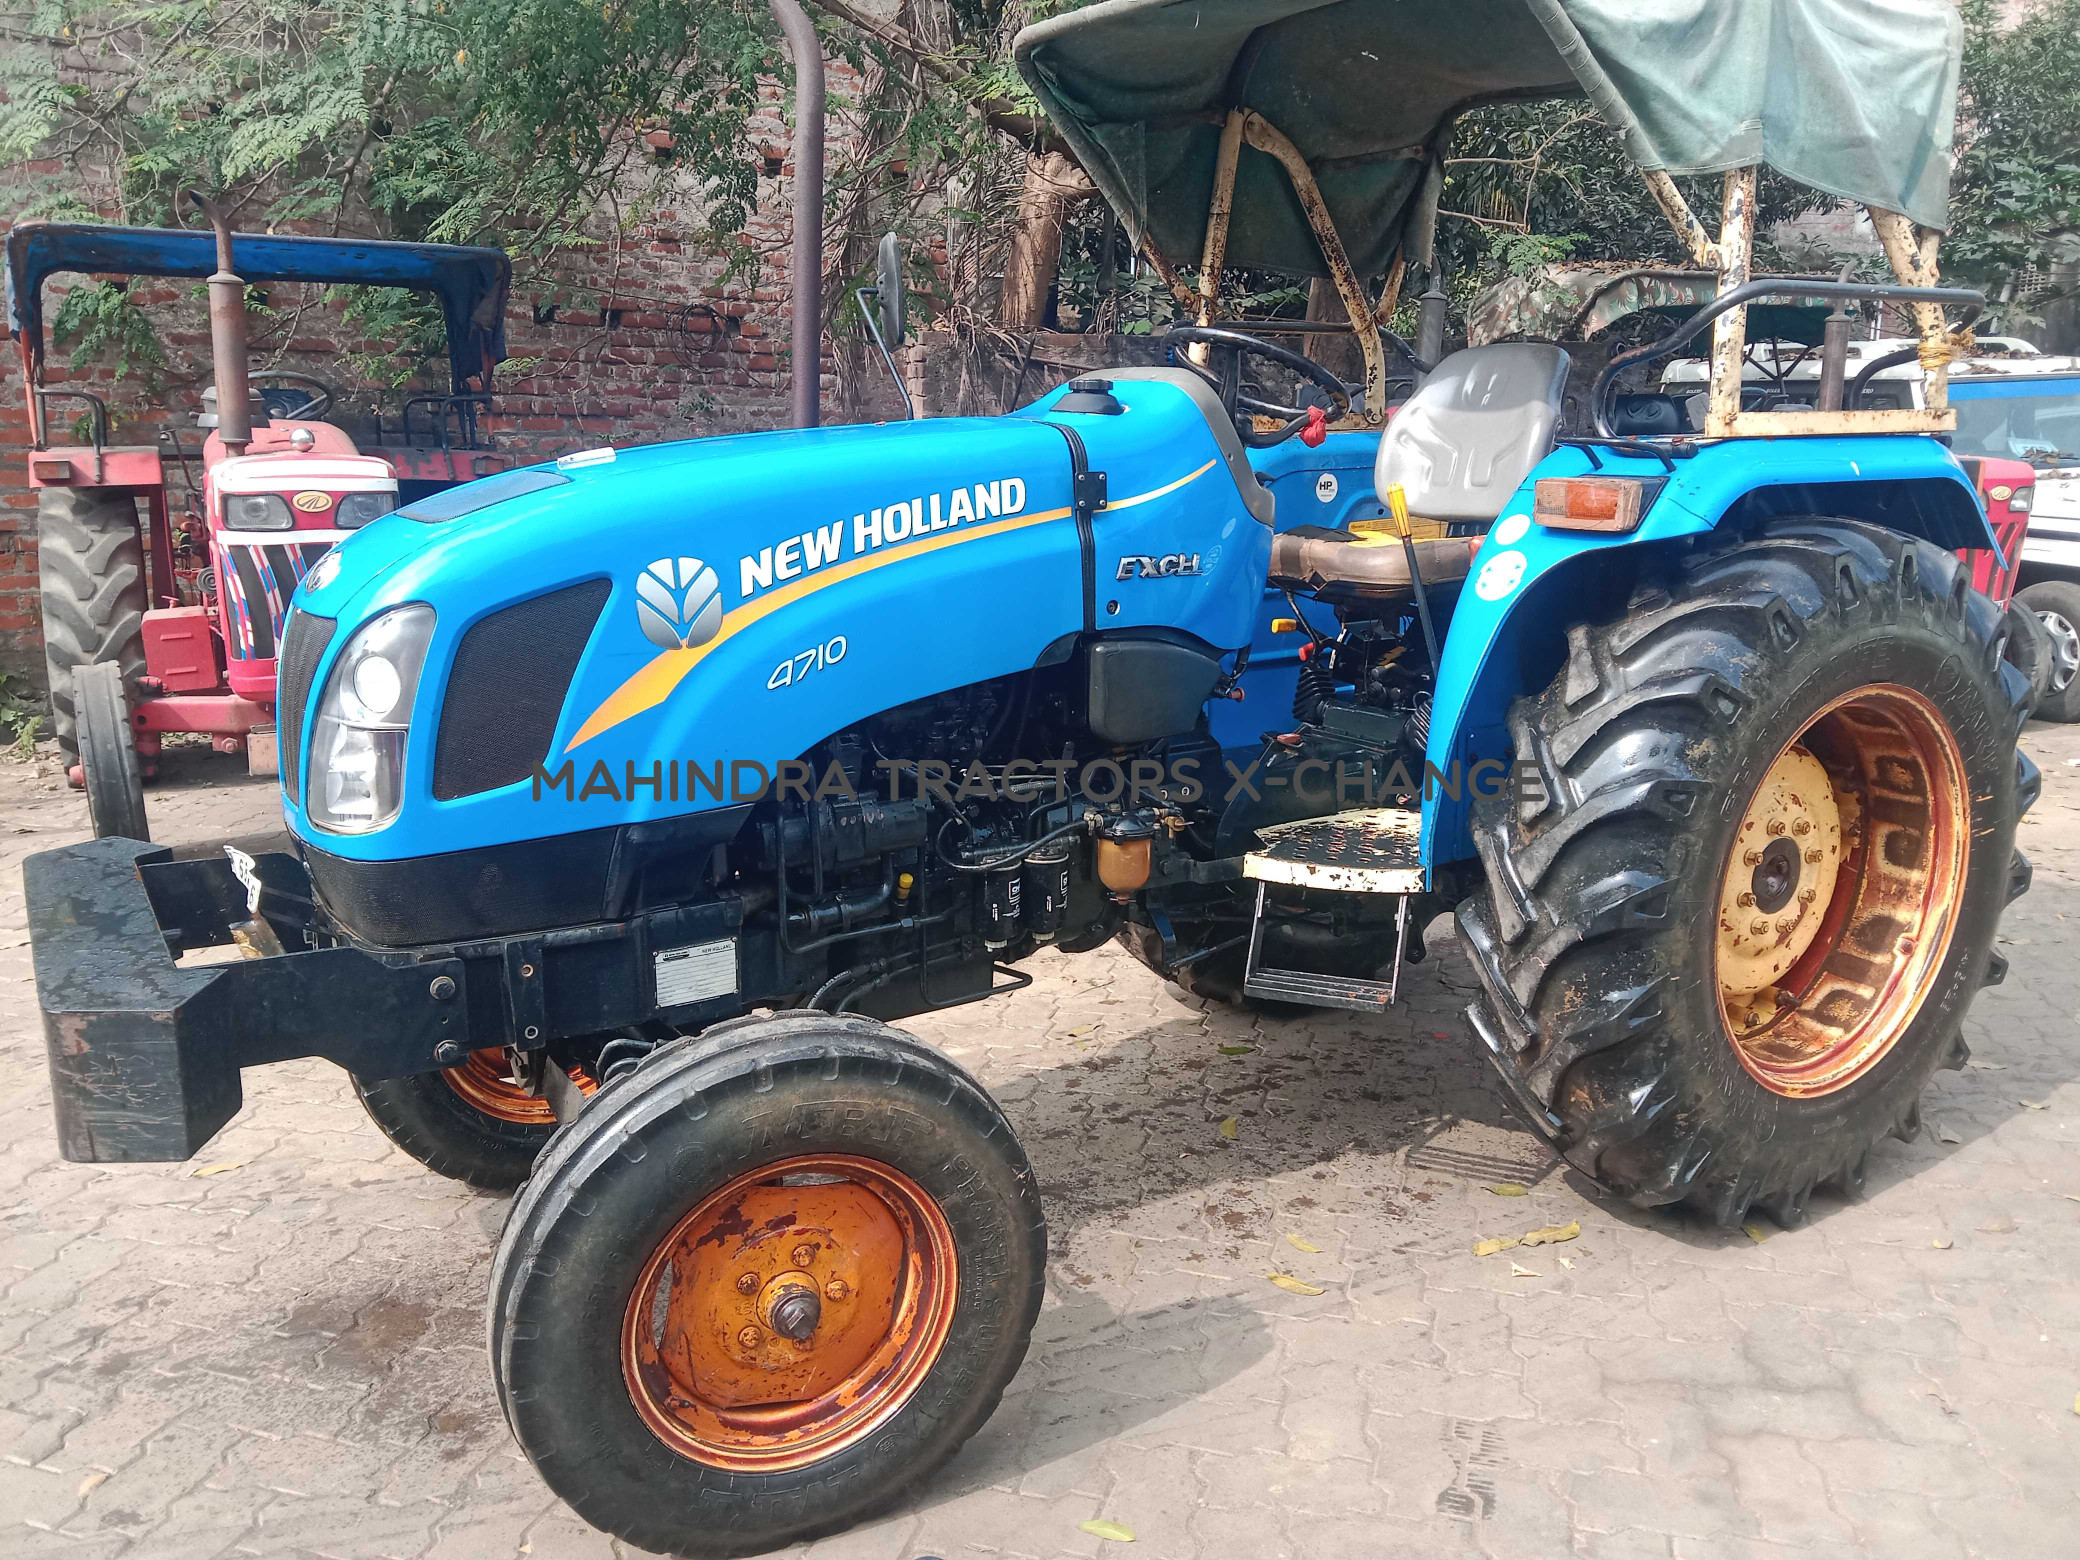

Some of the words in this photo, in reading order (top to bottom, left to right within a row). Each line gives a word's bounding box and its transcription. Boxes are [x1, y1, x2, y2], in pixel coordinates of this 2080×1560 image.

[1319, 480, 1333, 491] HP
[740, 519, 844, 598] NEW
[853, 477, 1026, 555] HOLLAND
[766, 634, 848, 691] 4710
[738, 1099, 938, 1160] MRF
